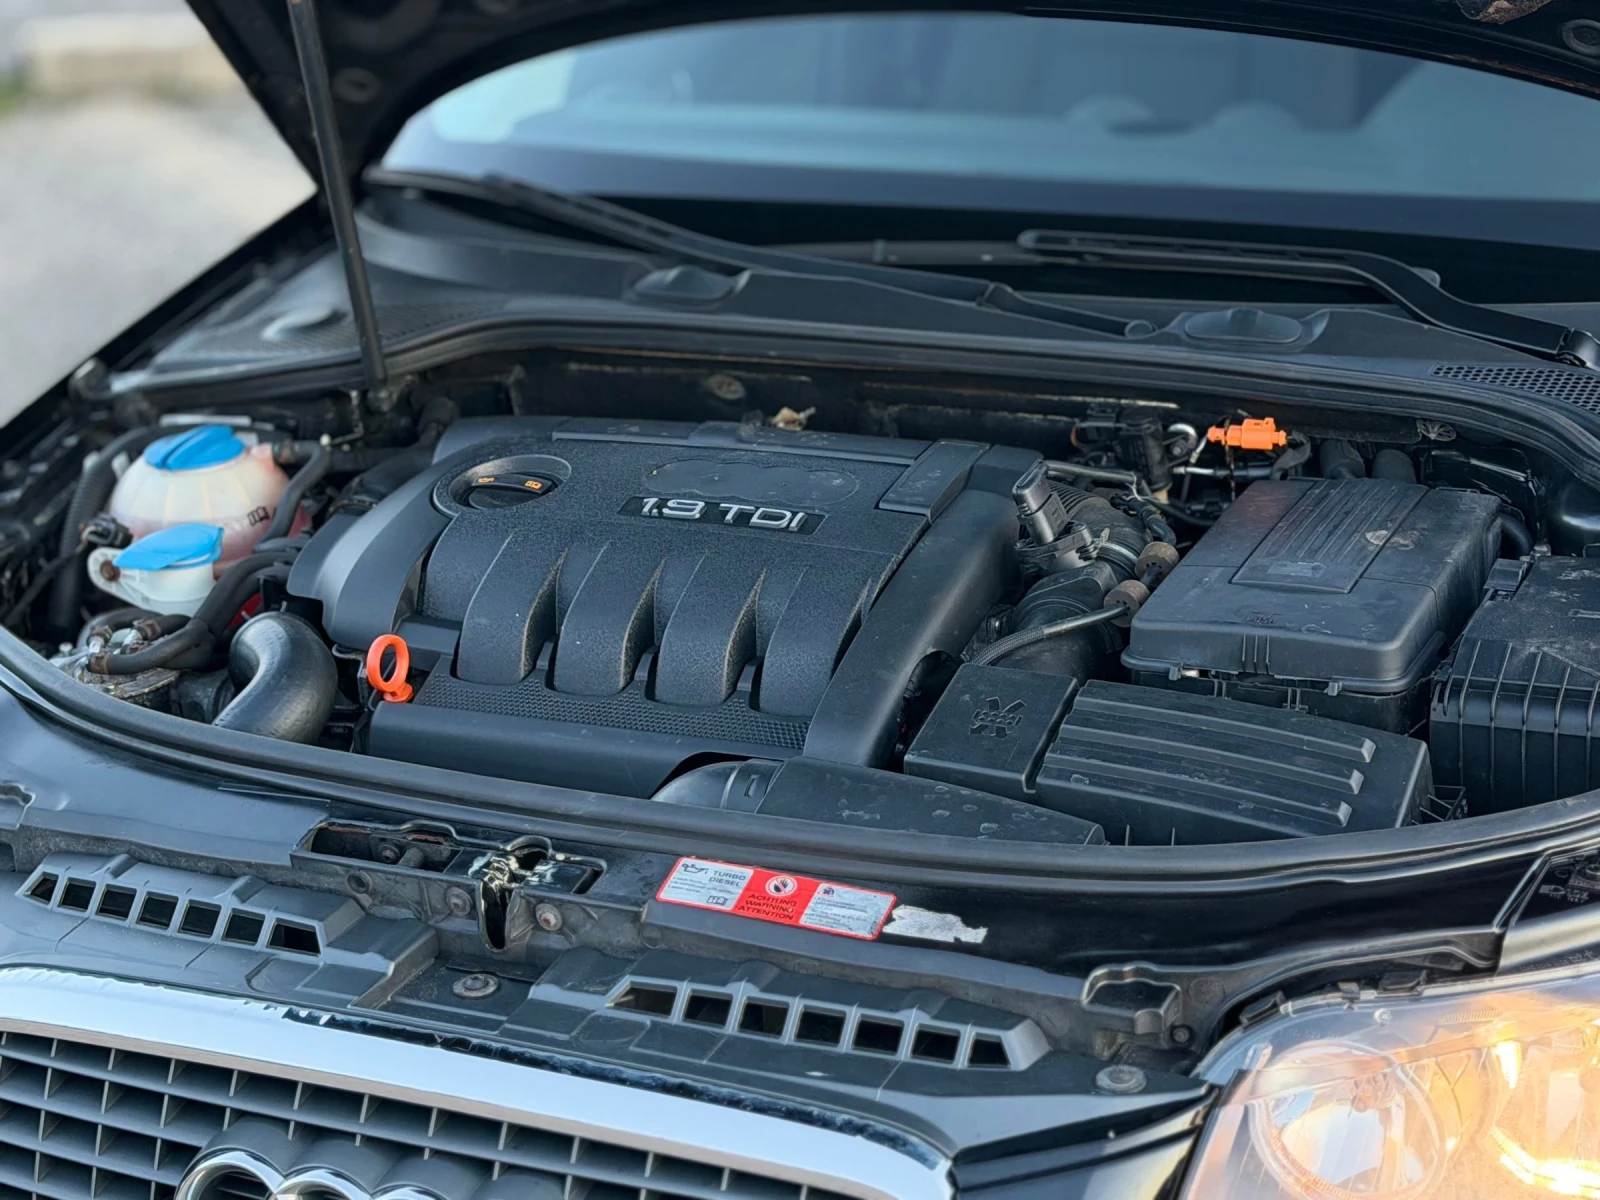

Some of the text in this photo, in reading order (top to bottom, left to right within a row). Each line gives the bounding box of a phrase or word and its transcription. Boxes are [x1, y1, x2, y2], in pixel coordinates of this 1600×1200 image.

[641, 497, 808, 531] 1.9 TDI
[708, 876, 741, 888] DIESEL
[713, 870, 746, 881] TURBO
[745, 900, 794, 913] WARNING
[748, 893, 797, 907] ACHTUNG
[738, 905, 794, 920] ATTENTION
